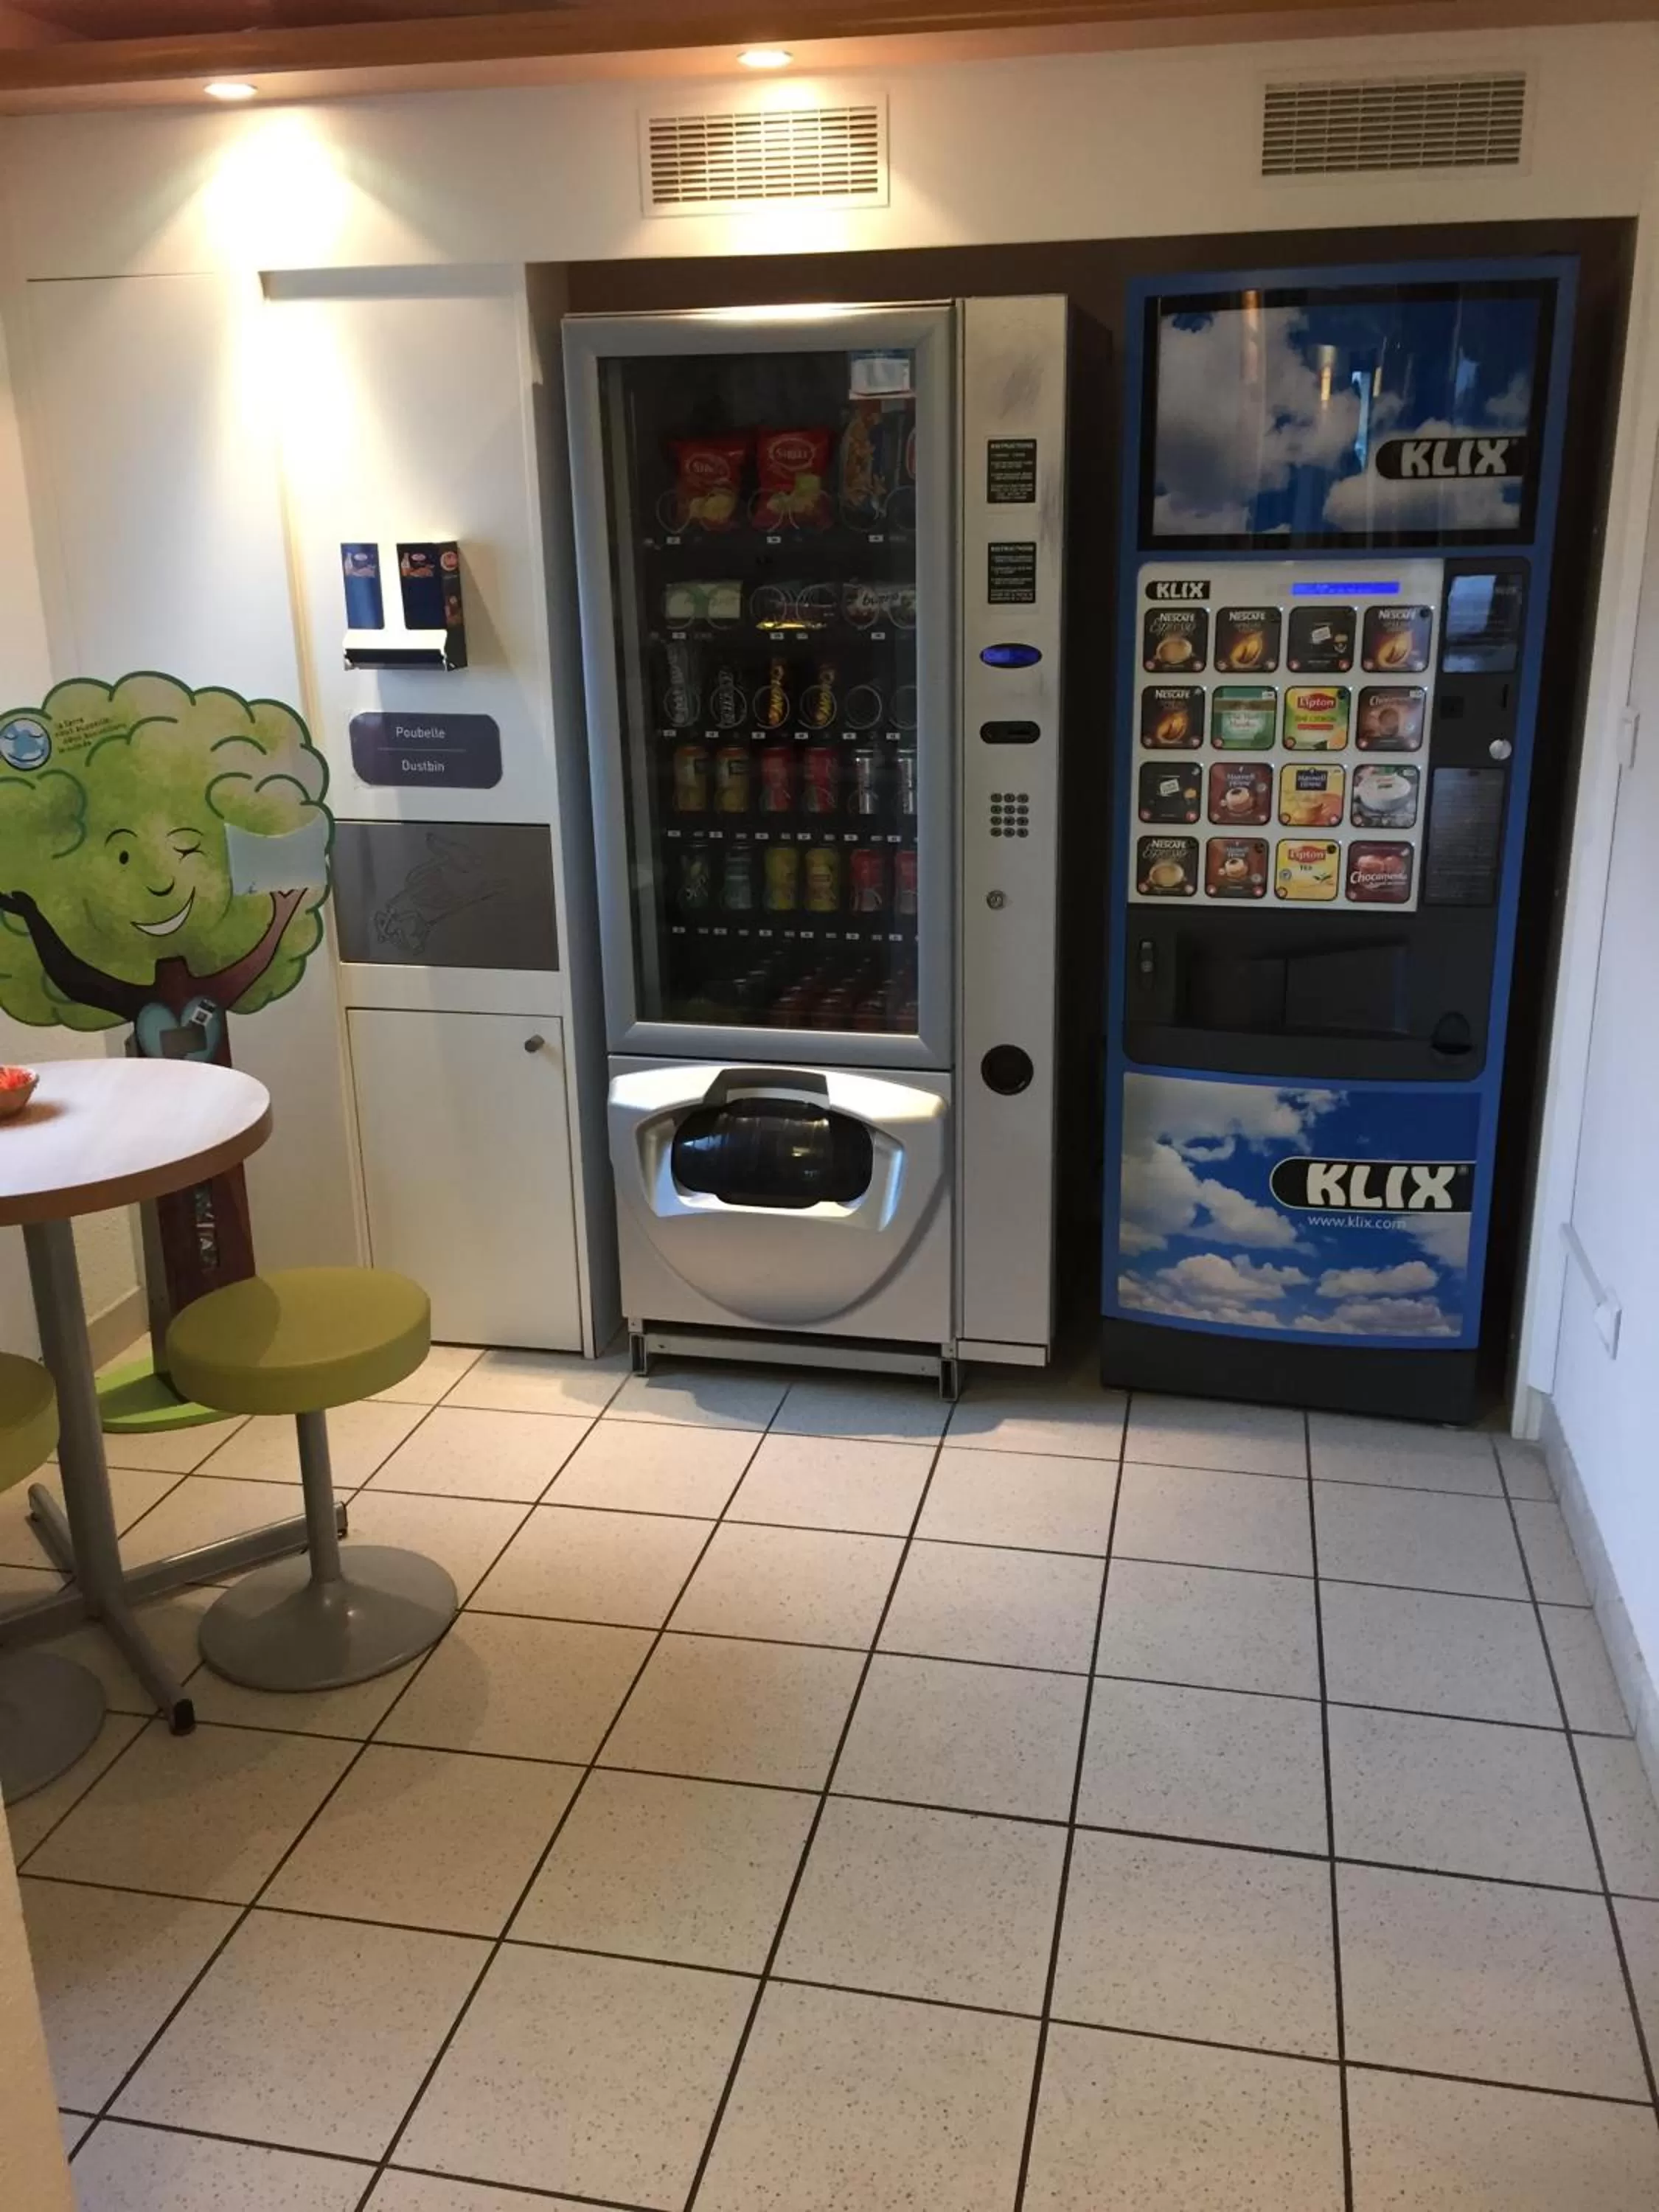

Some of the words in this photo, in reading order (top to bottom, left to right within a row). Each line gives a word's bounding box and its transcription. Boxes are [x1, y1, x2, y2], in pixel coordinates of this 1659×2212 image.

[1402, 439, 1509, 476] KLIX
[1156, 582, 1204, 599] KLIX
[1298, 695, 1335, 709] Lipton
[396, 726, 446, 739] Poubelle
[402, 759, 445, 773] Dustbin
[1290, 849, 1324, 860] Lipton
[1307, 1163, 1455, 1208] KLIX
[1308, 1216, 1407, 1229] www.klix.com
